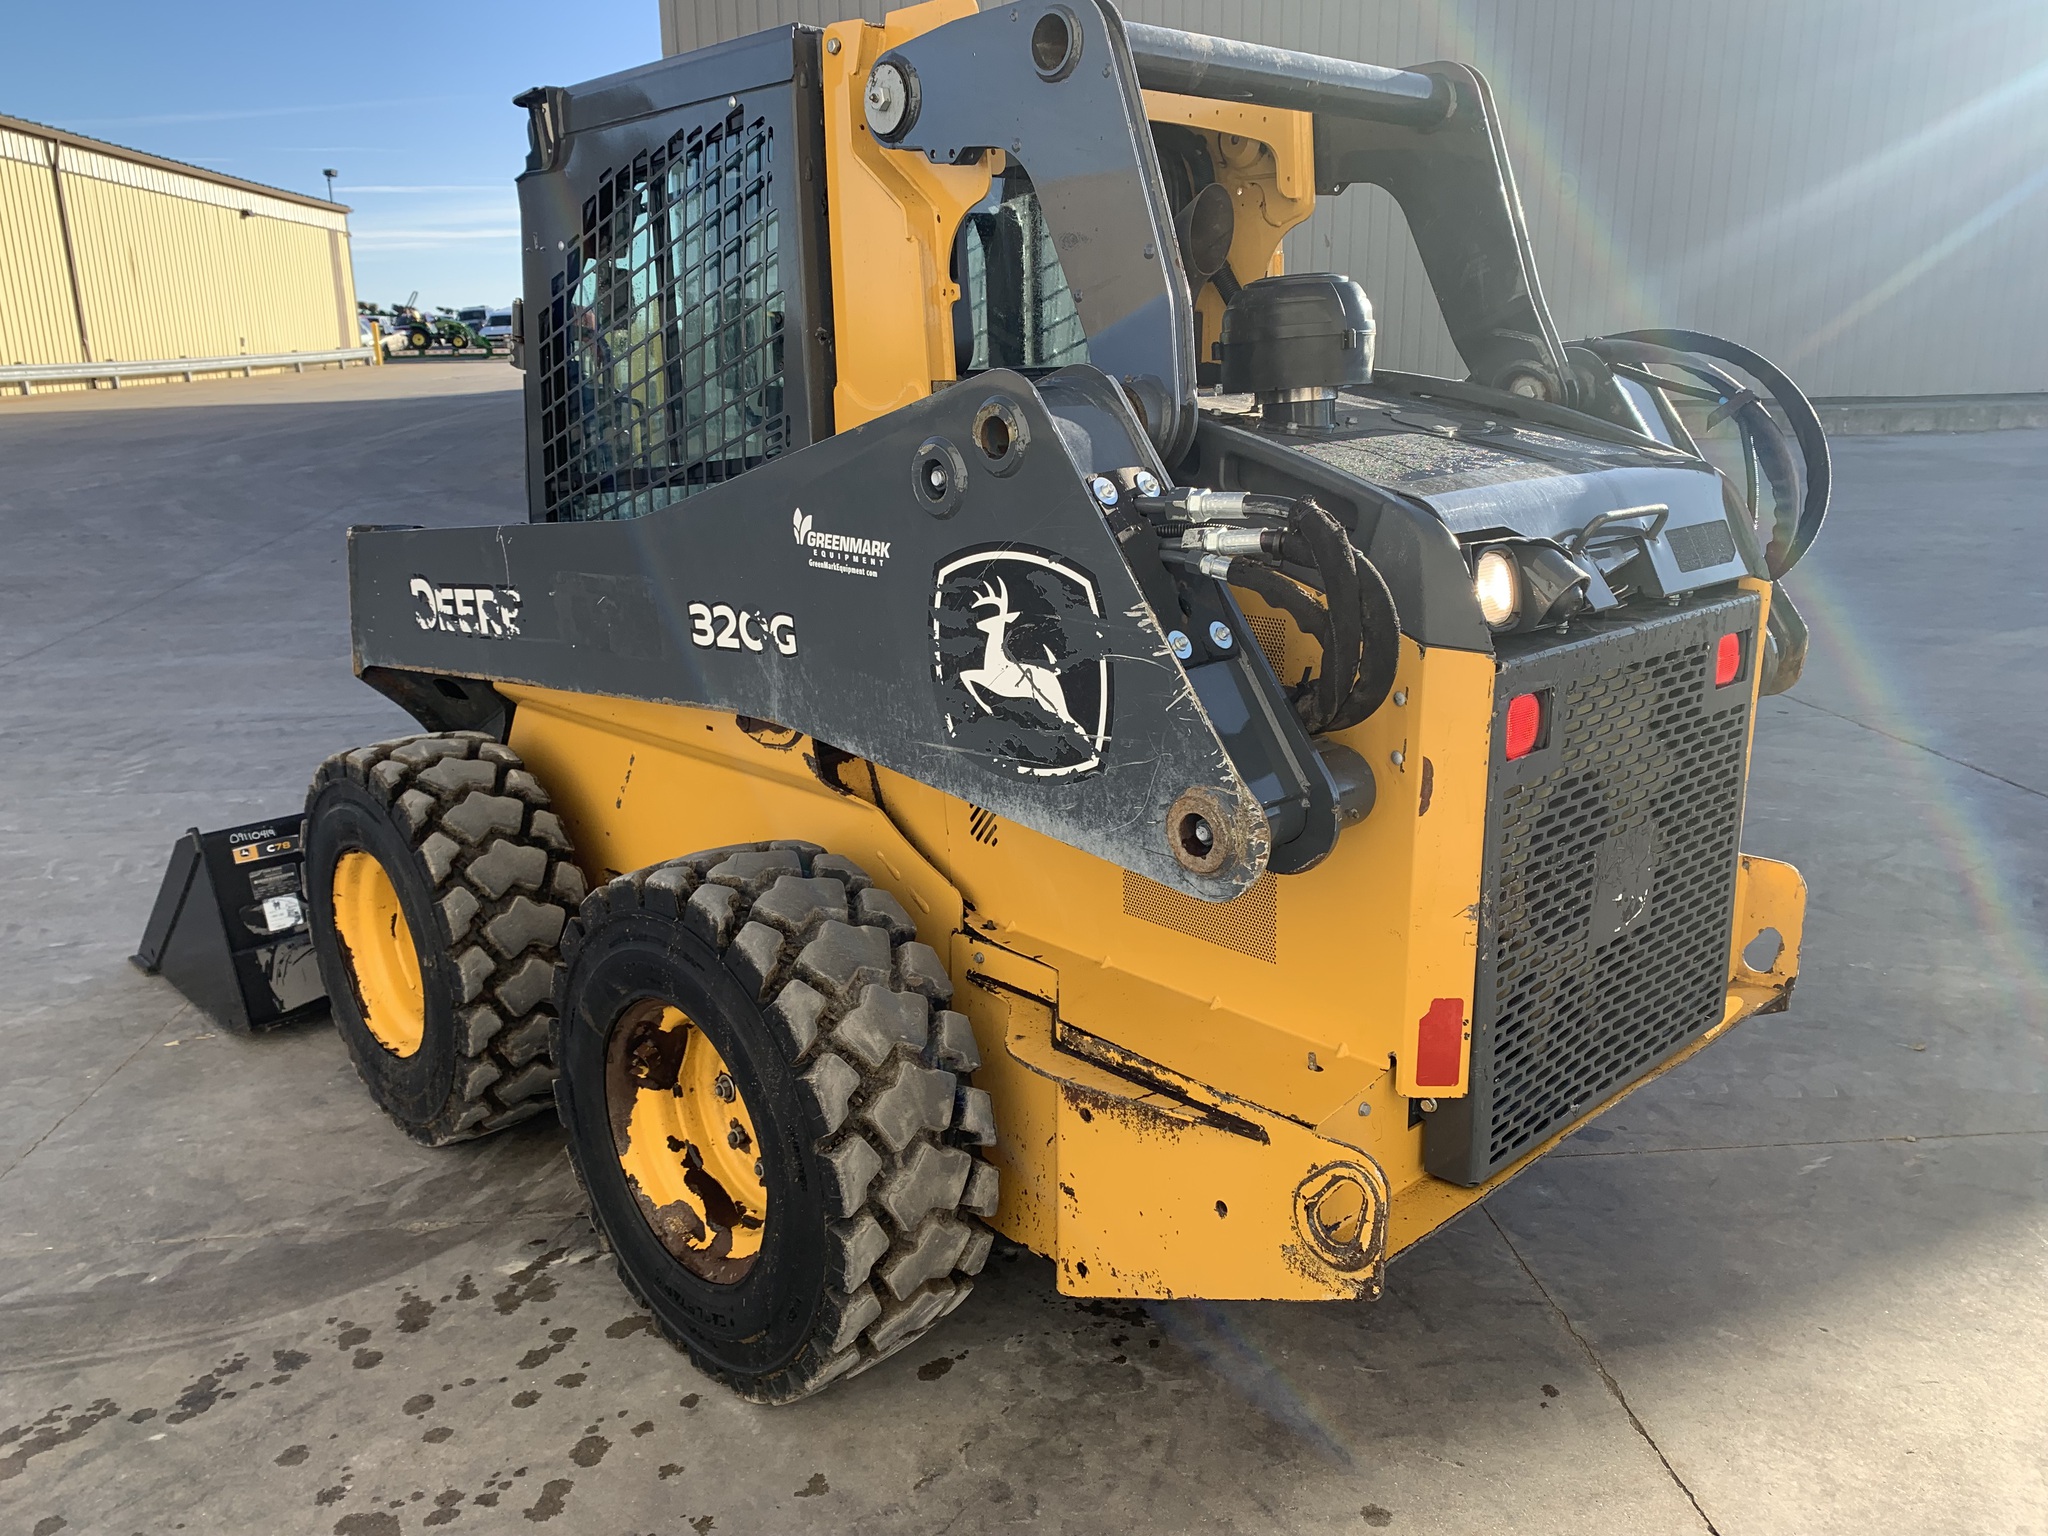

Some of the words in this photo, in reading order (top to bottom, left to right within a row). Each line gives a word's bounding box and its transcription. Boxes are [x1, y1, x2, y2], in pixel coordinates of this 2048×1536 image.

[807, 531, 892, 559] GREENMARK
[808, 558, 878, 578] GreenMarkEquipmentcom
[813, 549, 884, 567] EQUIPMENT
[688, 602, 798, 656] 320G
[266, 841, 292, 853] C78
